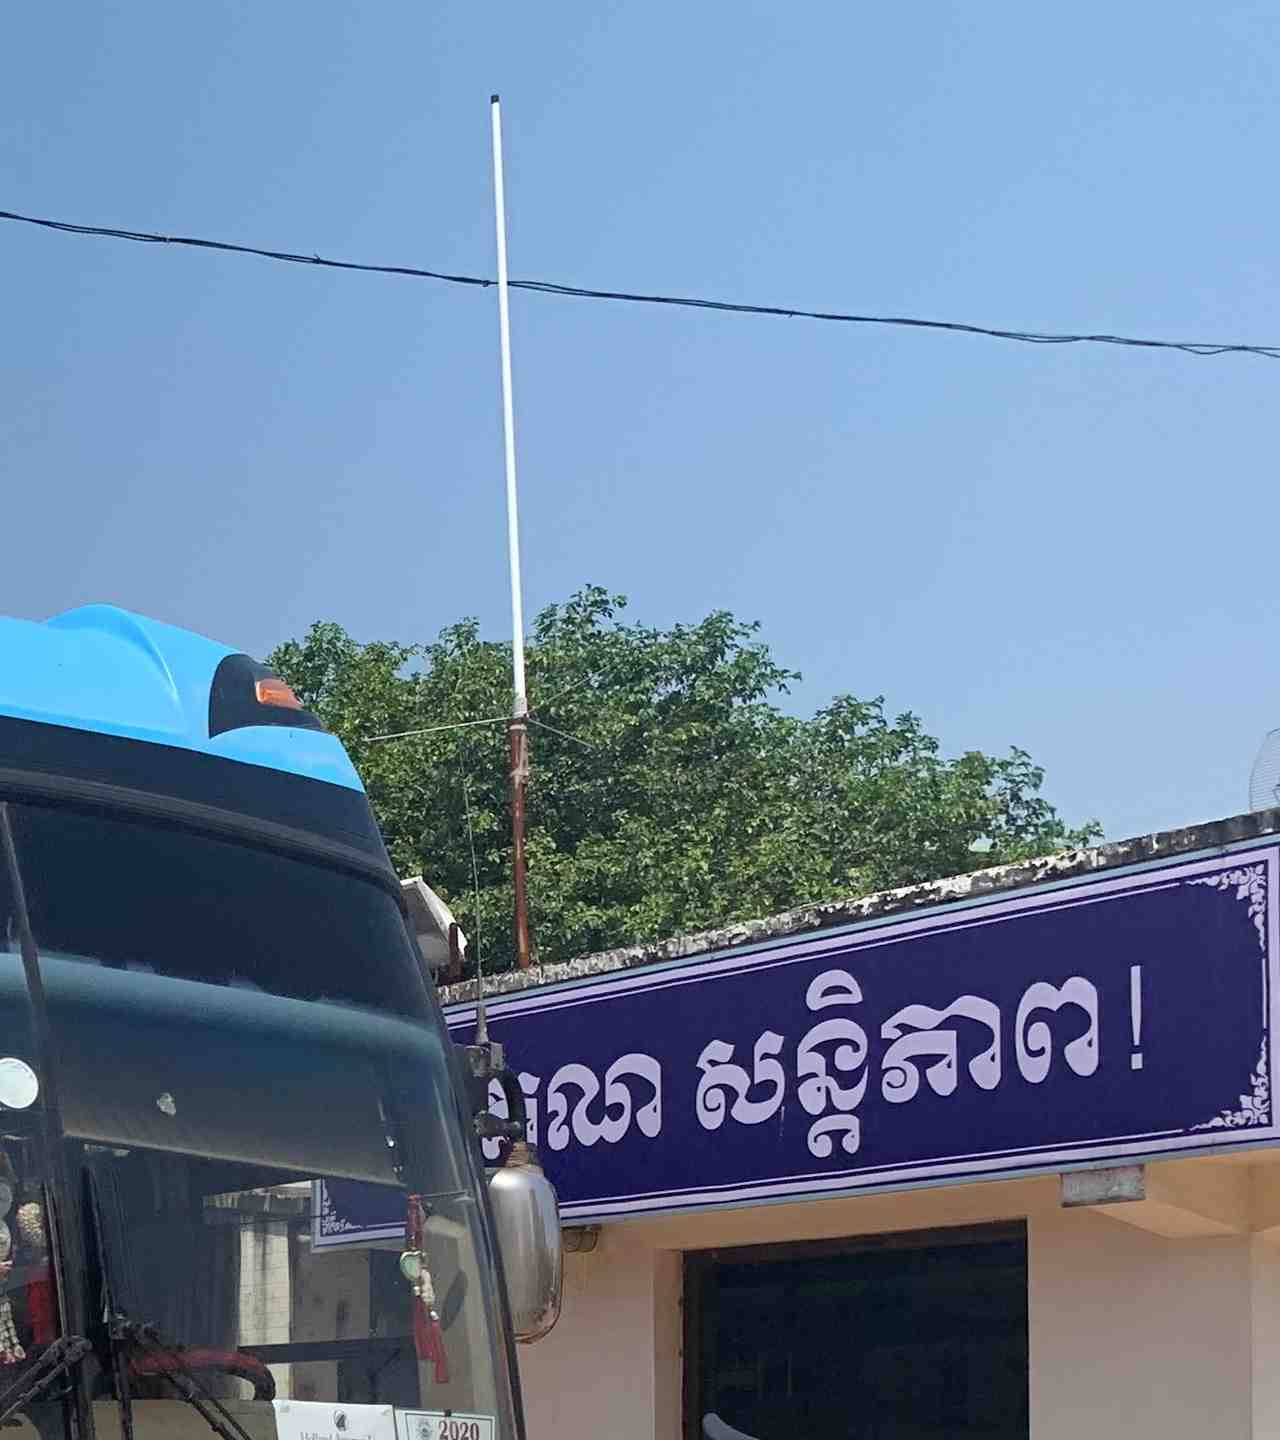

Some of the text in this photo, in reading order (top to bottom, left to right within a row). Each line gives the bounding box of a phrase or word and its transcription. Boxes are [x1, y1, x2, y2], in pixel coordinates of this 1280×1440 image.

[695, 969, 1099, 1158] សន្តិភាព
[1130, 965, 1144, 1070] !
